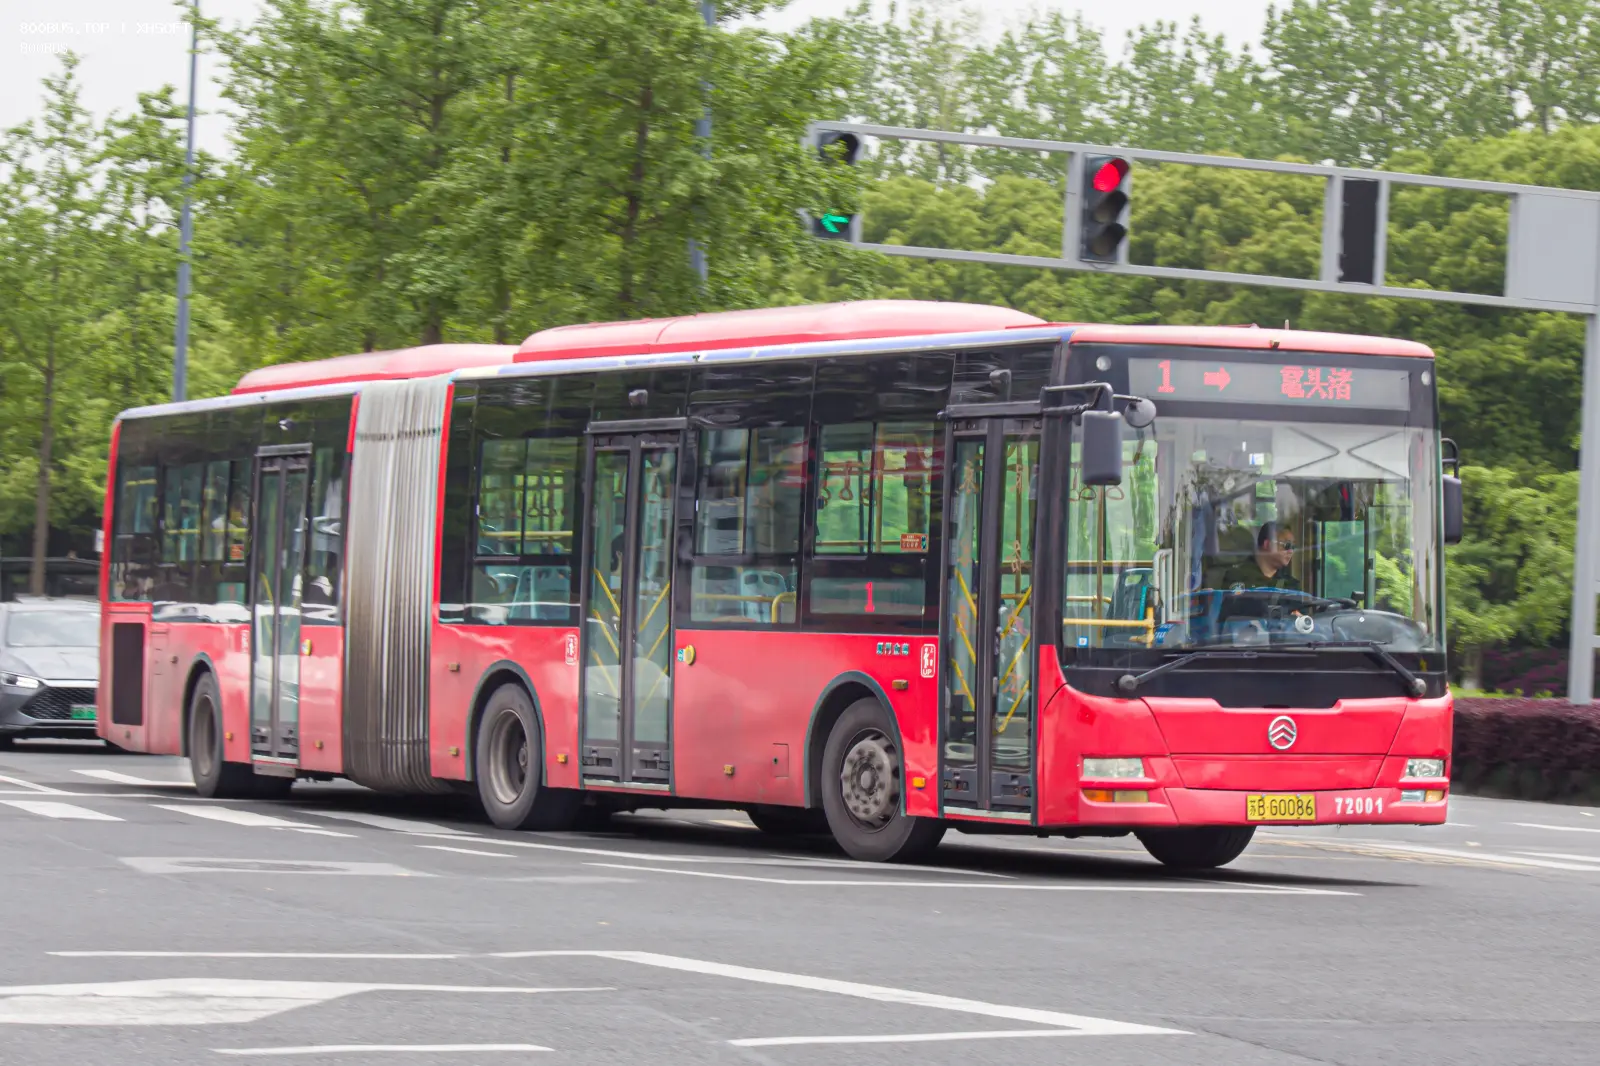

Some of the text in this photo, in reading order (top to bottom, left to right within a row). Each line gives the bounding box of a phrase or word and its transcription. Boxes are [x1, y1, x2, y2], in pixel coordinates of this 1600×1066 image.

[1157, 359, 1176, 393] 1
[864, 582, 875, 612] 1
[1334, 797, 1384, 815] 72001
